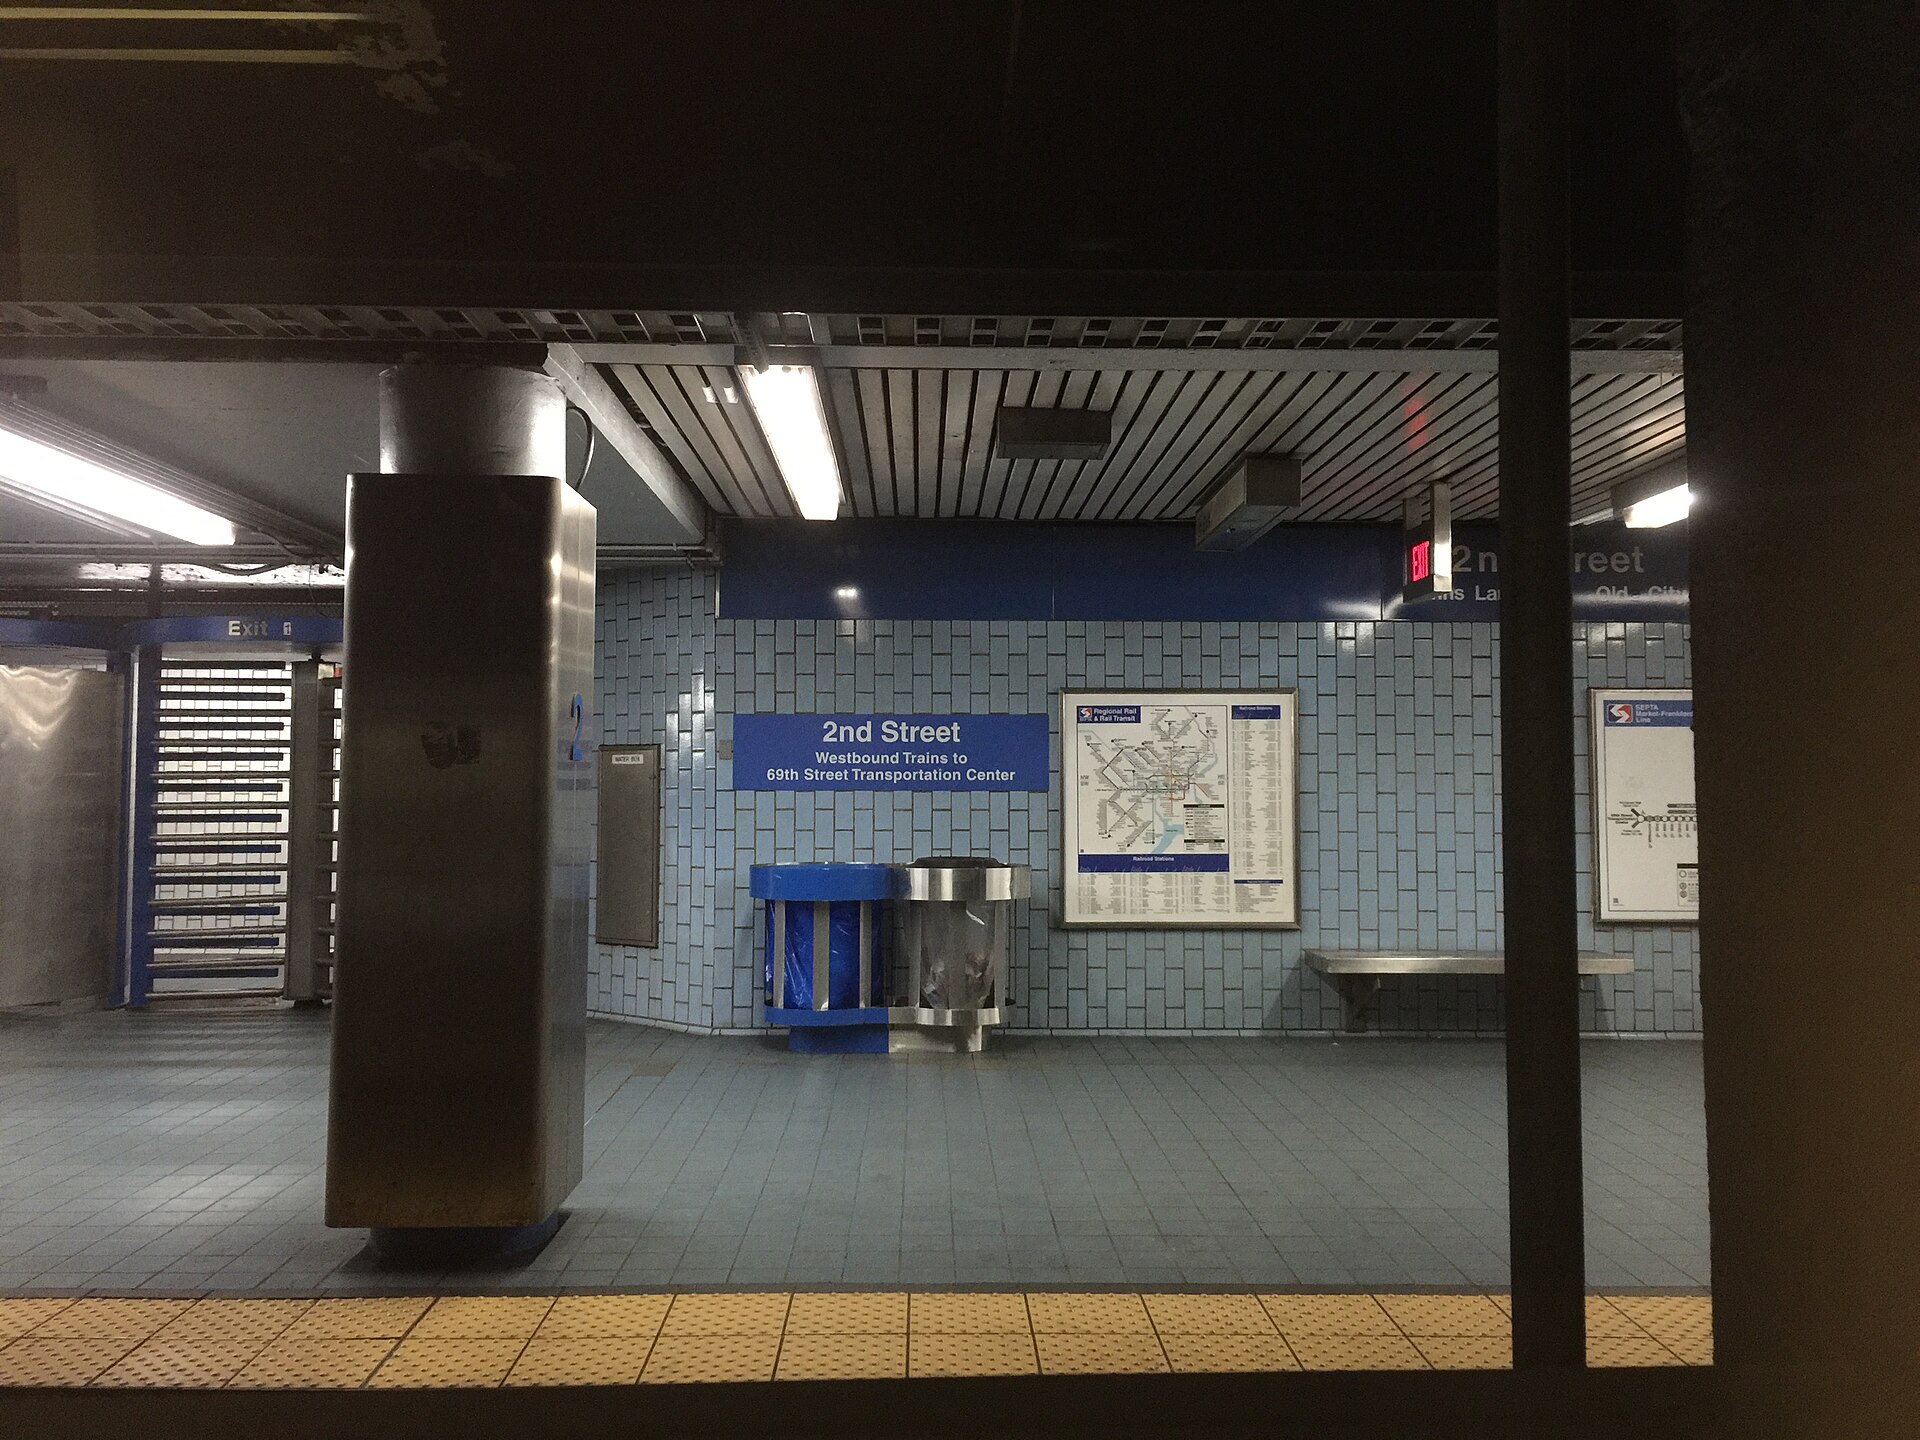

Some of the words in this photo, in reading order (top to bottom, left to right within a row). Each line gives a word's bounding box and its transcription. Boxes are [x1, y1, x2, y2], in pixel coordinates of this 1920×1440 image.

[1412, 541, 1430, 582] EXIT
[1453, 545, 1498, 573] 2n
[1574, 546, 1645, 573] reet
[228, 620, 268, 636] Exit
[1094, 708, 1123, 716] Regional
[823, 720, 873, 743] 2nd
[881, 720, 961, 743] Street
[815, 751, 899, 765] Westbound
[903, 751, 949, 765] Trains
[953, 753, 968, 765] to
[766, 768, 799, 781] 69th
[804, 768, 849, 781] Street
[851, 768, 962, 783] Transportation
[966, 768, 1016, 781] Center
